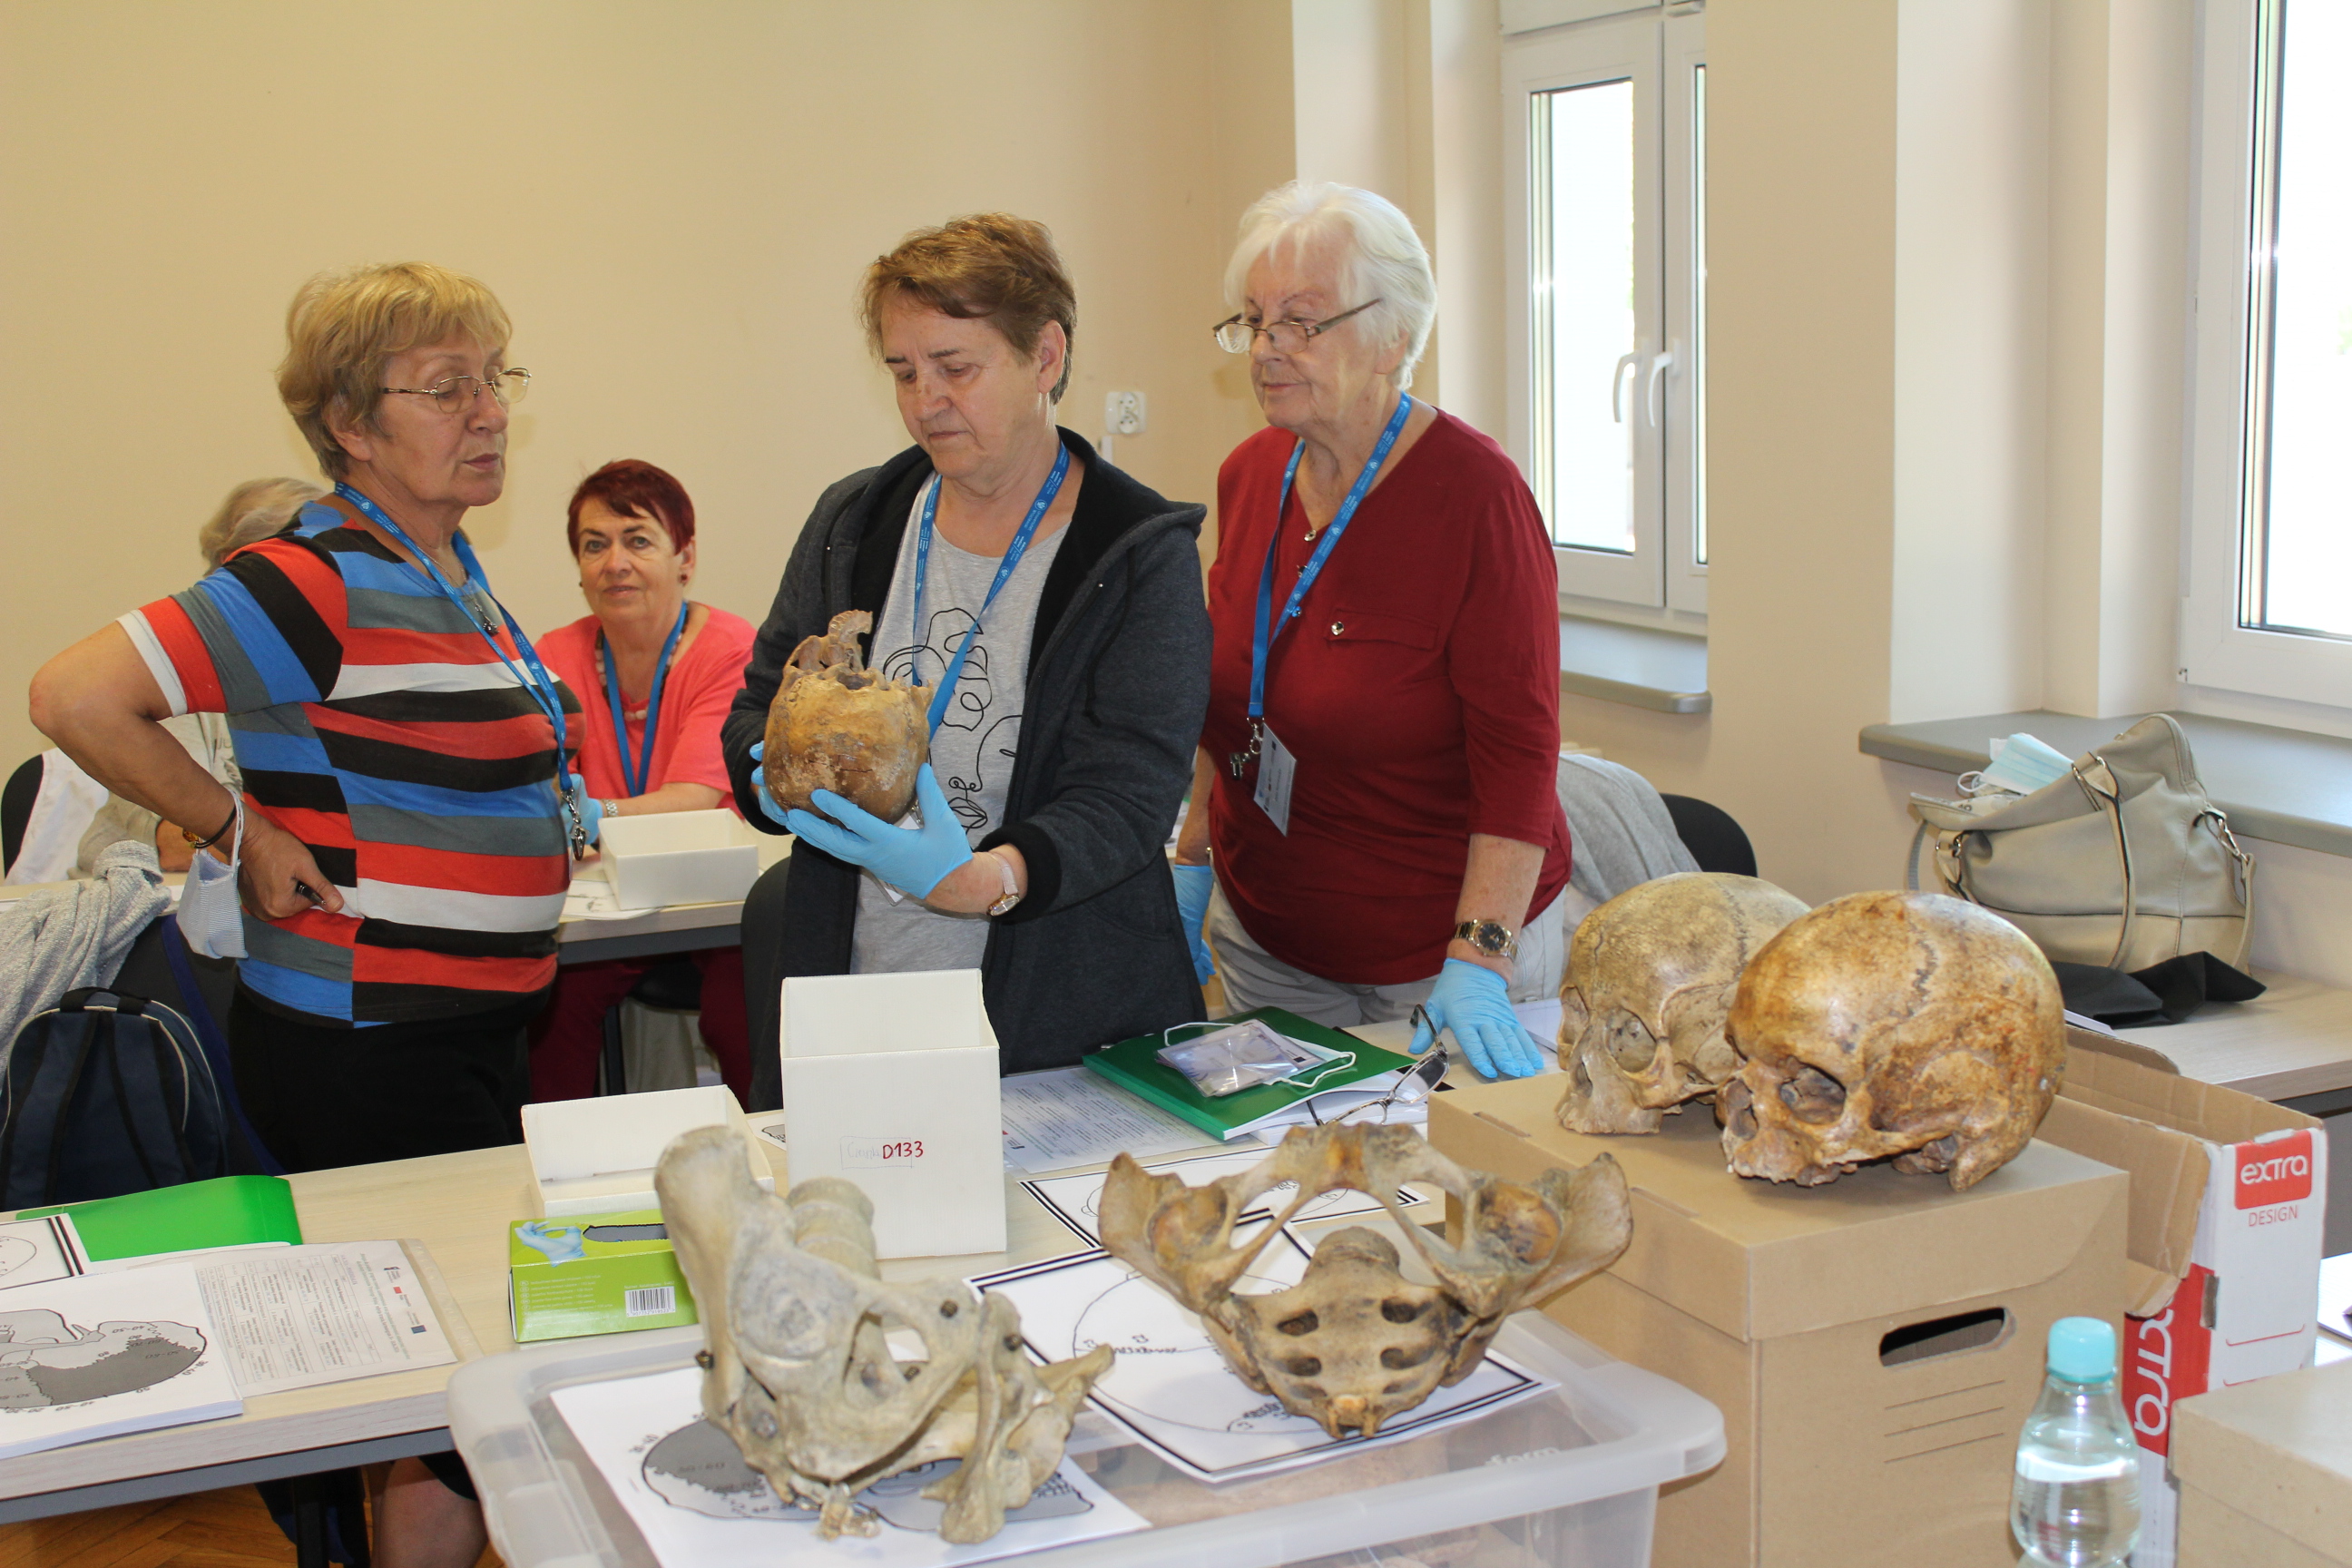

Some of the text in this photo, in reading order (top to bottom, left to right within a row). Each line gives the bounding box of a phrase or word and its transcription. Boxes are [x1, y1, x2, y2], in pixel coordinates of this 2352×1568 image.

[883, 1141, 924, 1160] D133
[2240, 1154, 2308, 1185] extra
[2248, 1205, 2298, 1228] DESIGN
[2133, 1298, 2175, 1436] xtra
